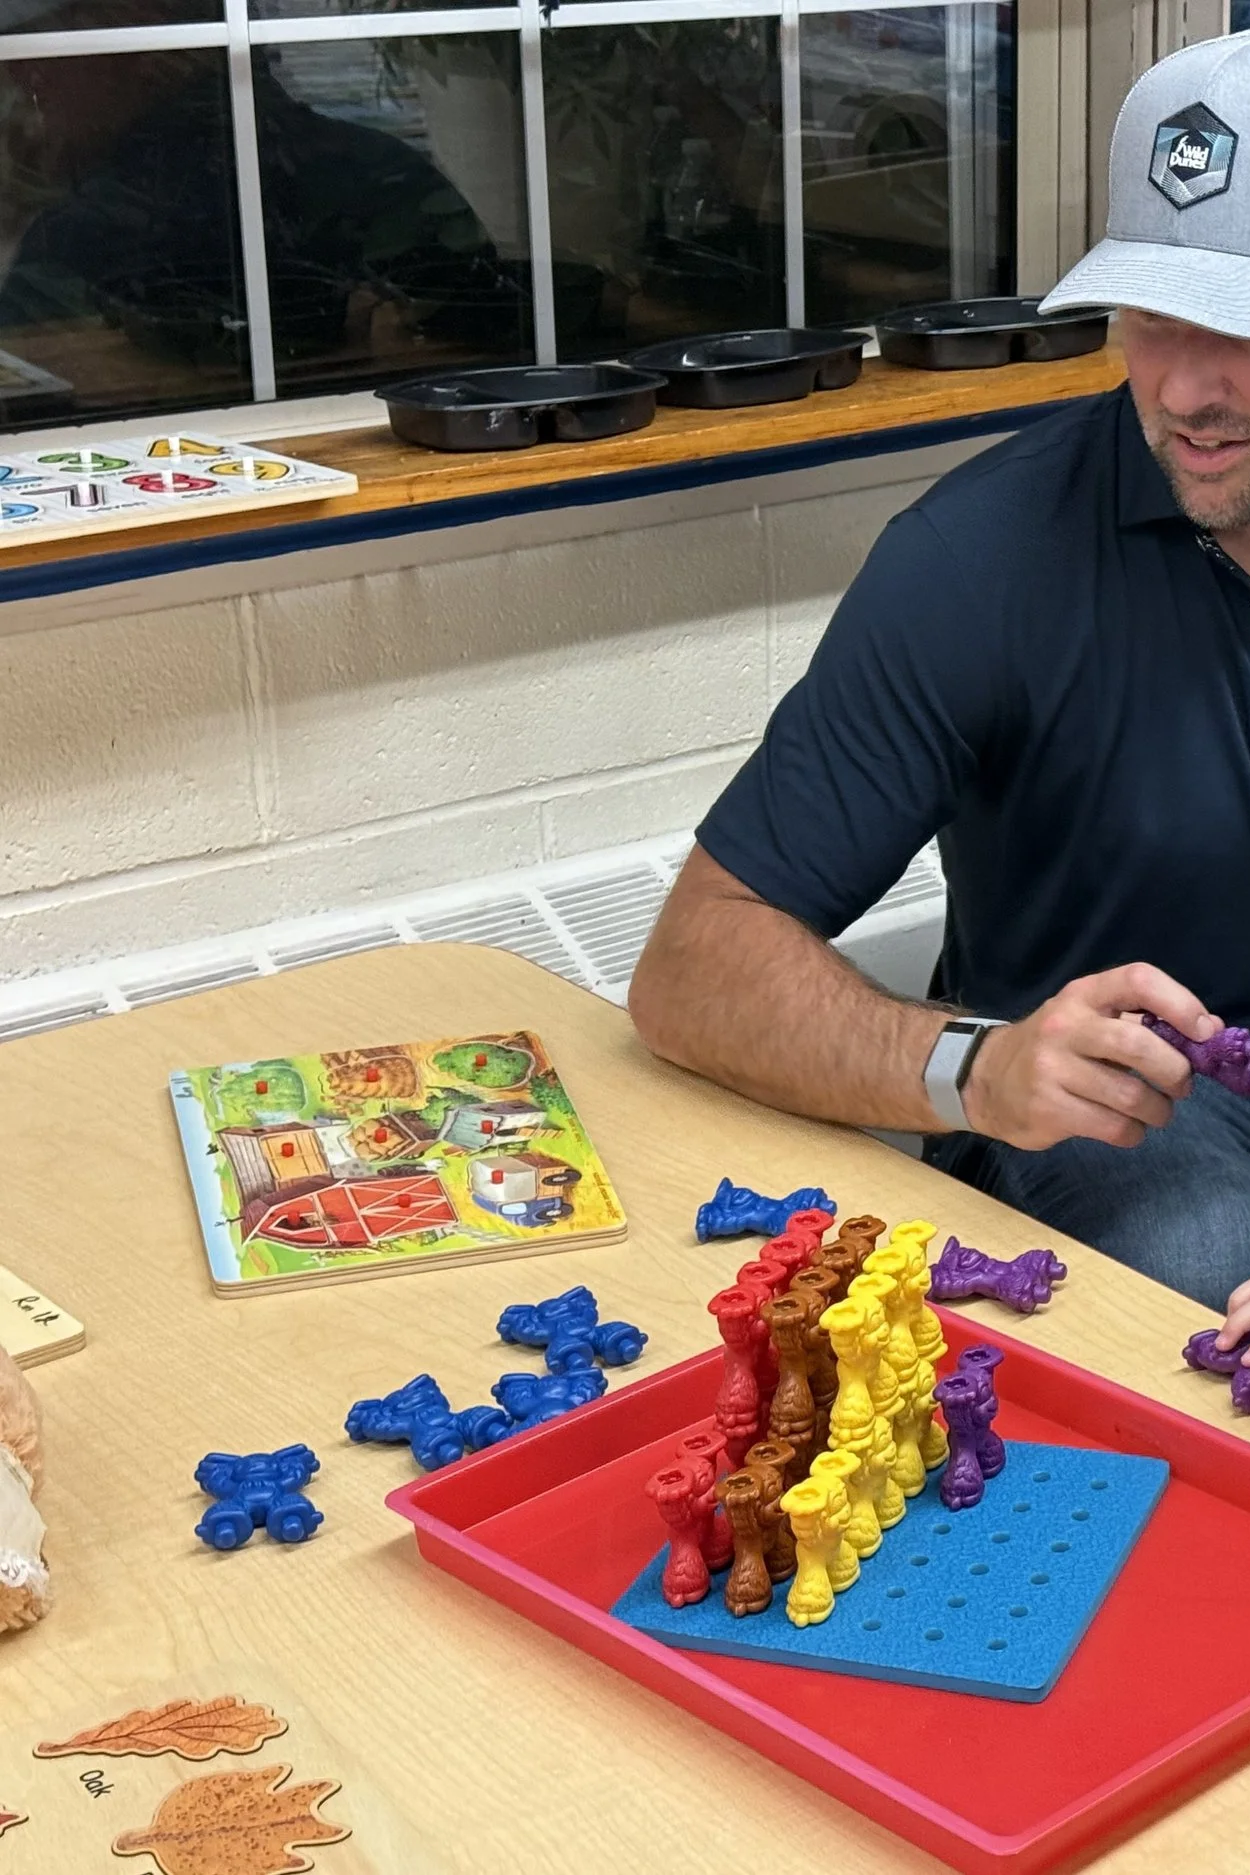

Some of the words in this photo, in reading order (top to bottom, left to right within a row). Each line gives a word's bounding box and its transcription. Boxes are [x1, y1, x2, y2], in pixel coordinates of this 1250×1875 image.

[1170, 153, 1206, 169] Dunes
[1182, 144, 1209, 161] Wild
[79, 1769, 115, 1799] Oak
